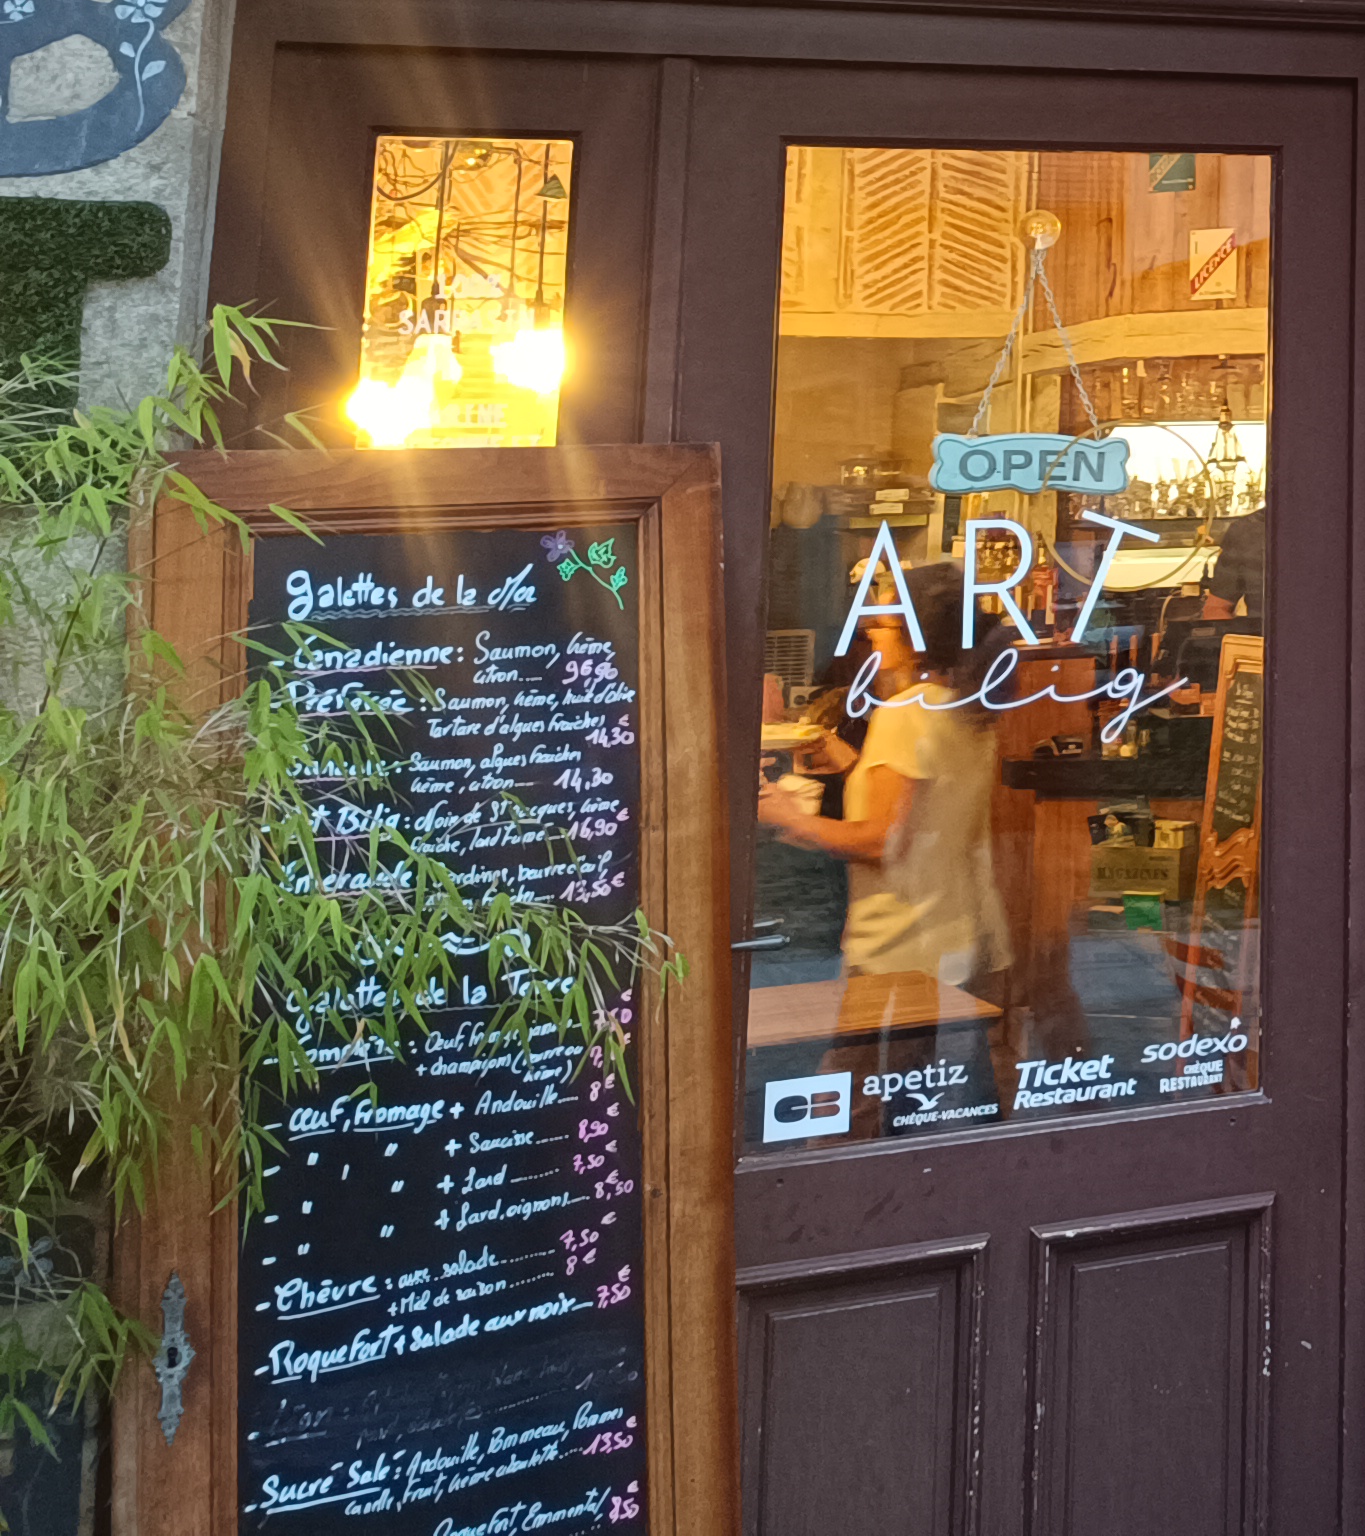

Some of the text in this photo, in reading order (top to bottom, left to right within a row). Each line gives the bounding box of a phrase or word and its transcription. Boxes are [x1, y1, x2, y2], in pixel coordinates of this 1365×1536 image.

[957, 448, 1106, 484] OPEN
[412, 576, 446, 608] de
[456, 574, 477, 606] la
[834, 509, 1161, 657] ART
[473, 630, 560, 670] Saumon,
[845, 647, 1189, 745] bilig
[462, 975, 488, 1006] la
[1140, 1033, 1248, 1063] sodexo
[862, 1058, 969, 1102] apetiz
[1015, 1053, 1115, 1089] Ticket
[1159, 1073, 1223, 1093] RESTAURANT
[773, 1090, 841, 1124] CB
[1013, 1077, 1137, 1111] Restaurant
